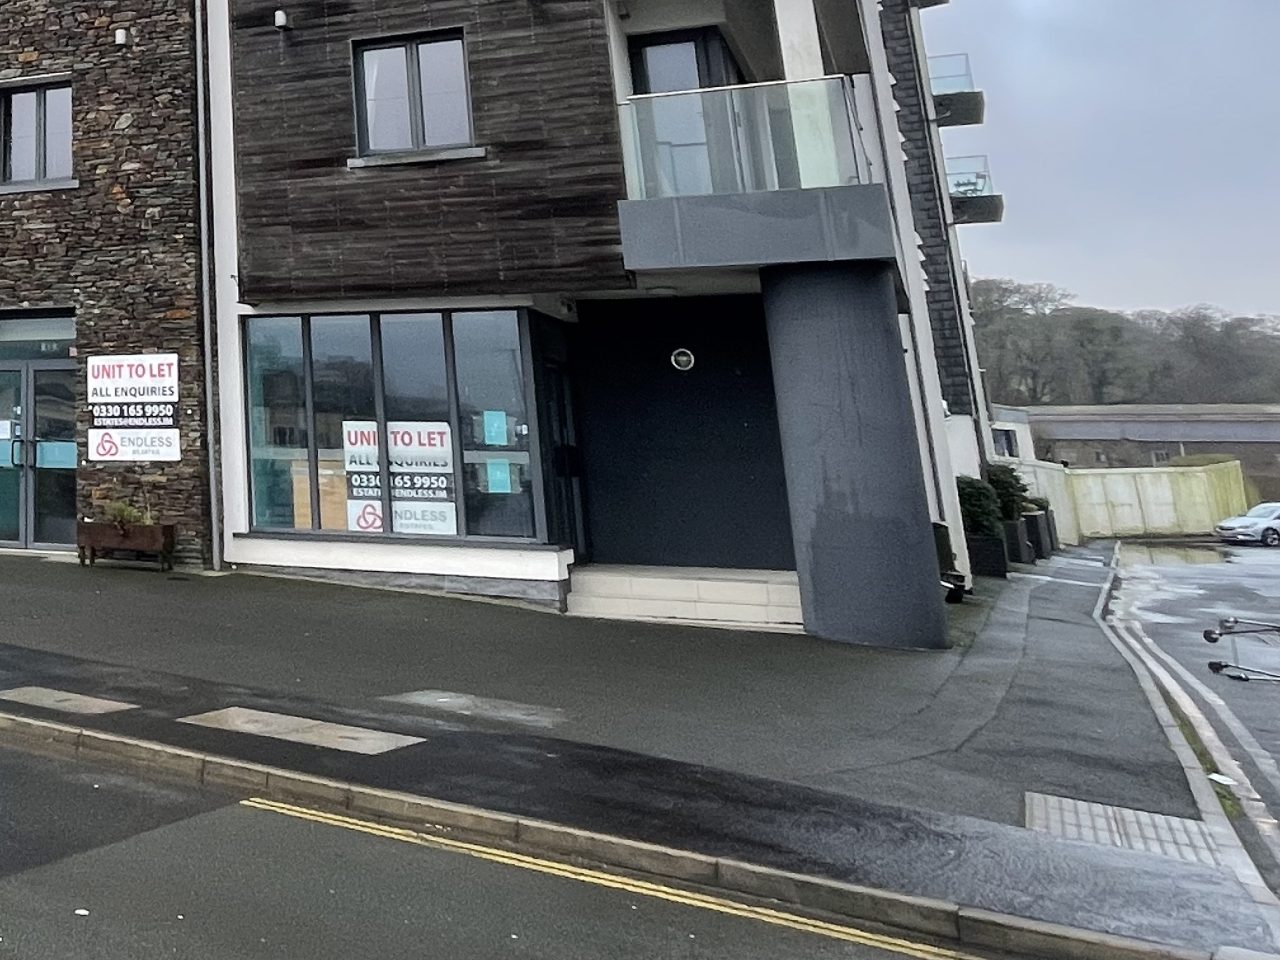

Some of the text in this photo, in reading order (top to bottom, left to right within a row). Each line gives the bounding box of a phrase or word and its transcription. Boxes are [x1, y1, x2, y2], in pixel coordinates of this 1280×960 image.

[91, 362, 174, 380] UNIT TO LET
[91, 386, 175, 398] ALL ENQUIRIES
[93, 404, 174, 417] 0330 165 9950
[120, 436, 173, 448] ENDLESS
[347, 430, 447, 448] UNI TO LET
[349, 454, 372, 466] ALL
[413, 476, 447, 489] 9950
[394, 509, 447, 522] NDLESS
